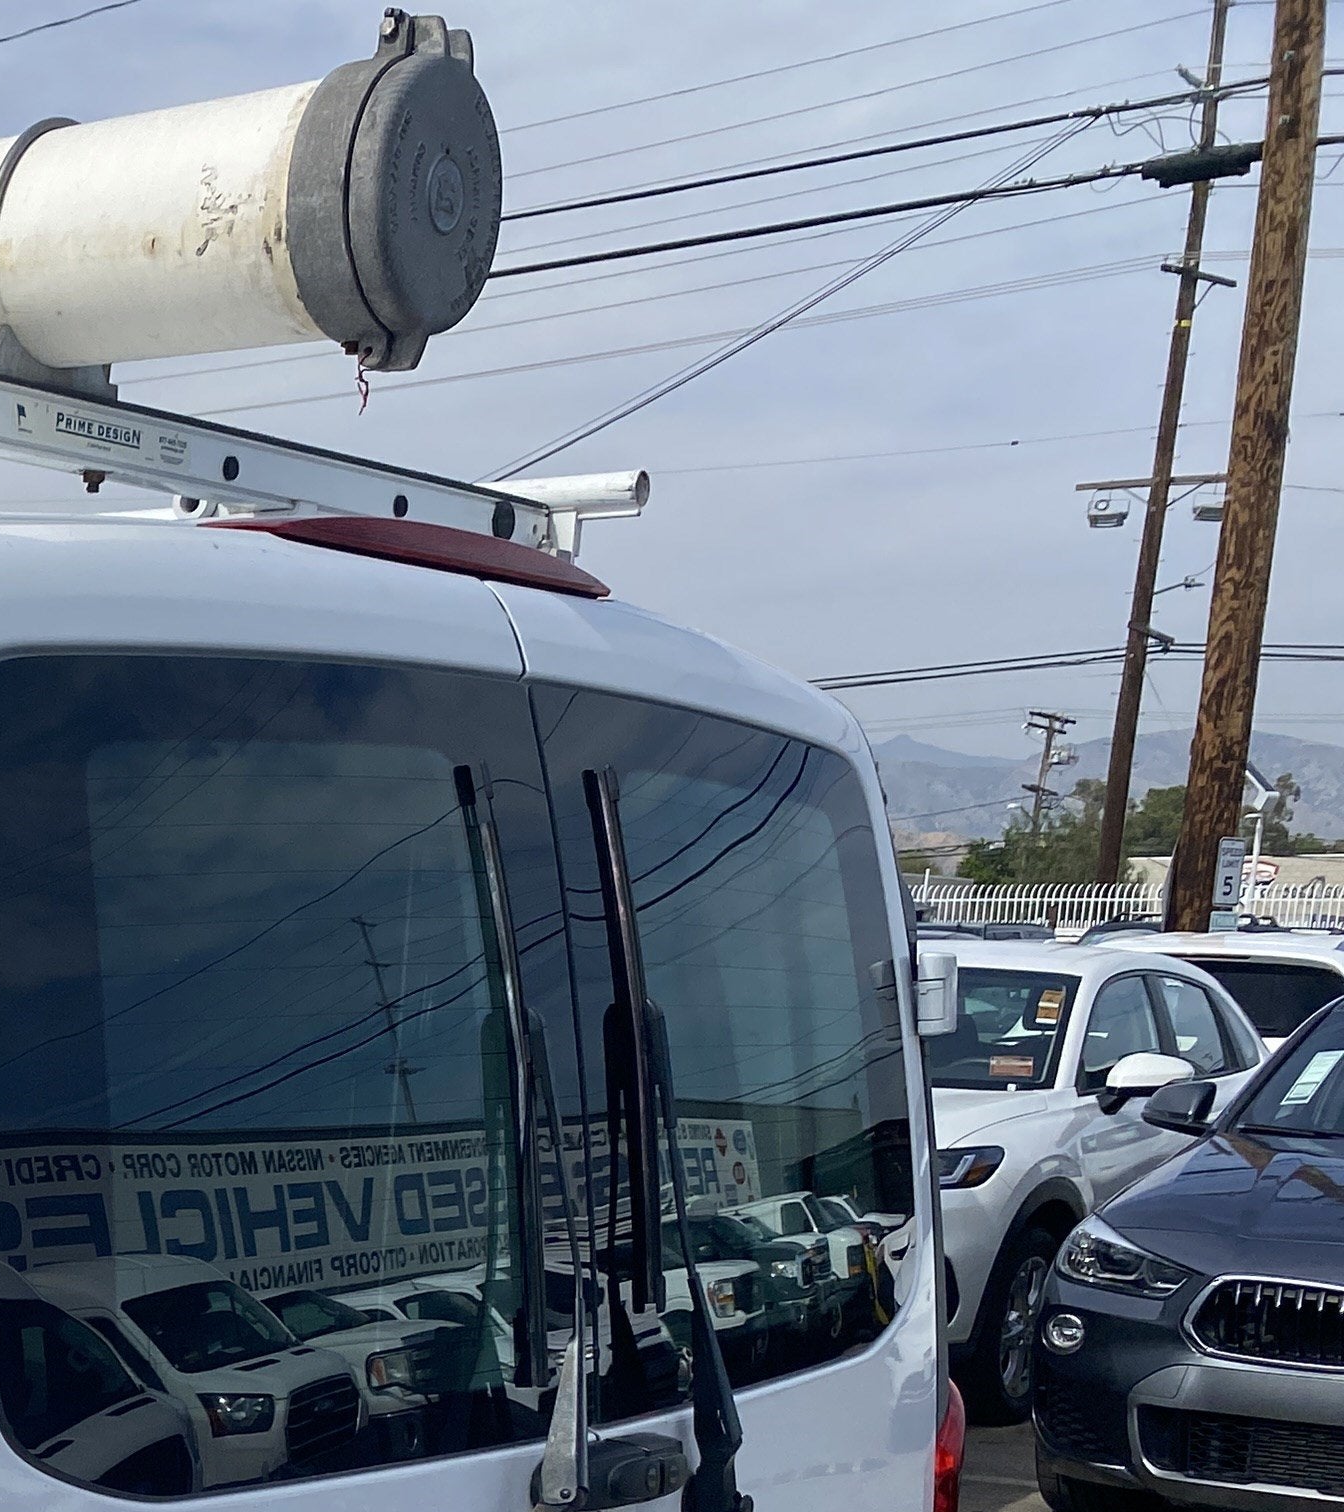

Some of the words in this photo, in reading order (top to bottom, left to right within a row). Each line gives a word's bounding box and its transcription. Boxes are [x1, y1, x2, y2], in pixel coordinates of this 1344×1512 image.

[56, 412, 93, 435] PRIME
[97, 425, 141, 445] DESIGN
[1222, 876, 1233, 896] 5
